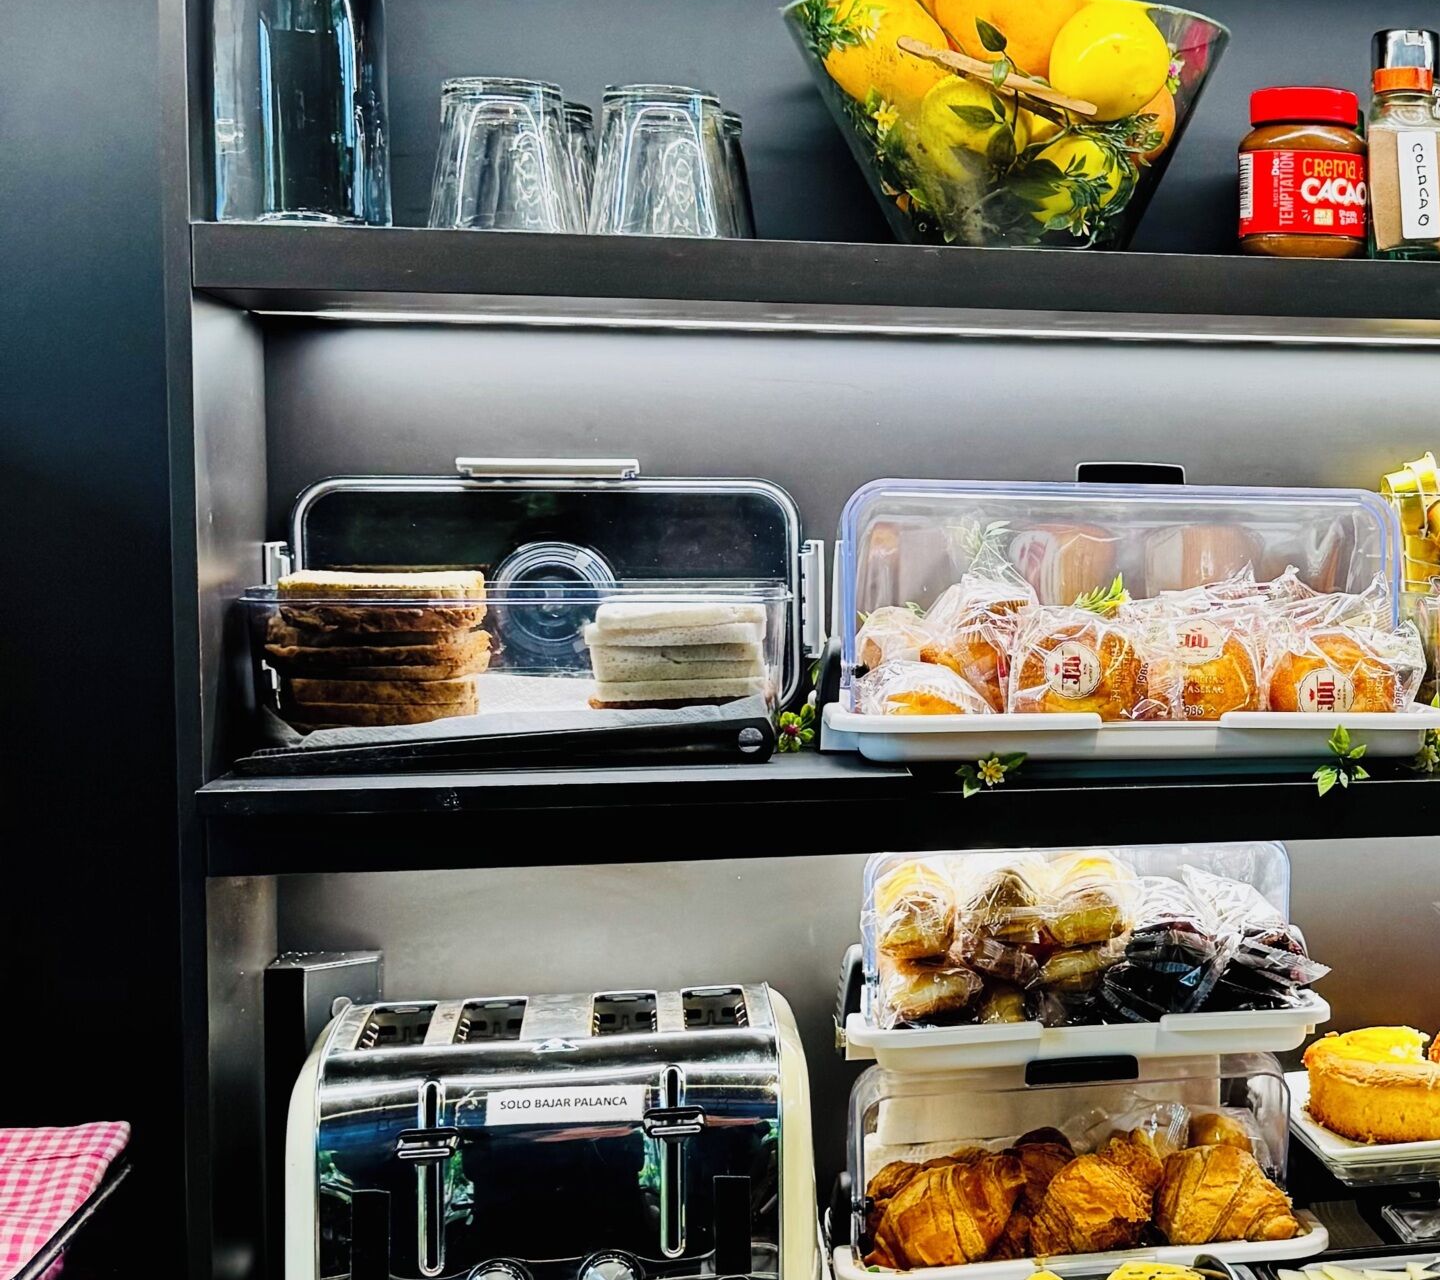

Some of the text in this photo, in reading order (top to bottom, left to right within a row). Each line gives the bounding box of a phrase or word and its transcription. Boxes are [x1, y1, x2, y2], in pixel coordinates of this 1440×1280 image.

[1279, 152, 1295, 226] TEMPTATION
[1300, 177, 1367, 207] CACAO
[1183, 703, 1205, 716] 986
[500, 1096, 628, 1110] SOLO BAJAR PALANCA
